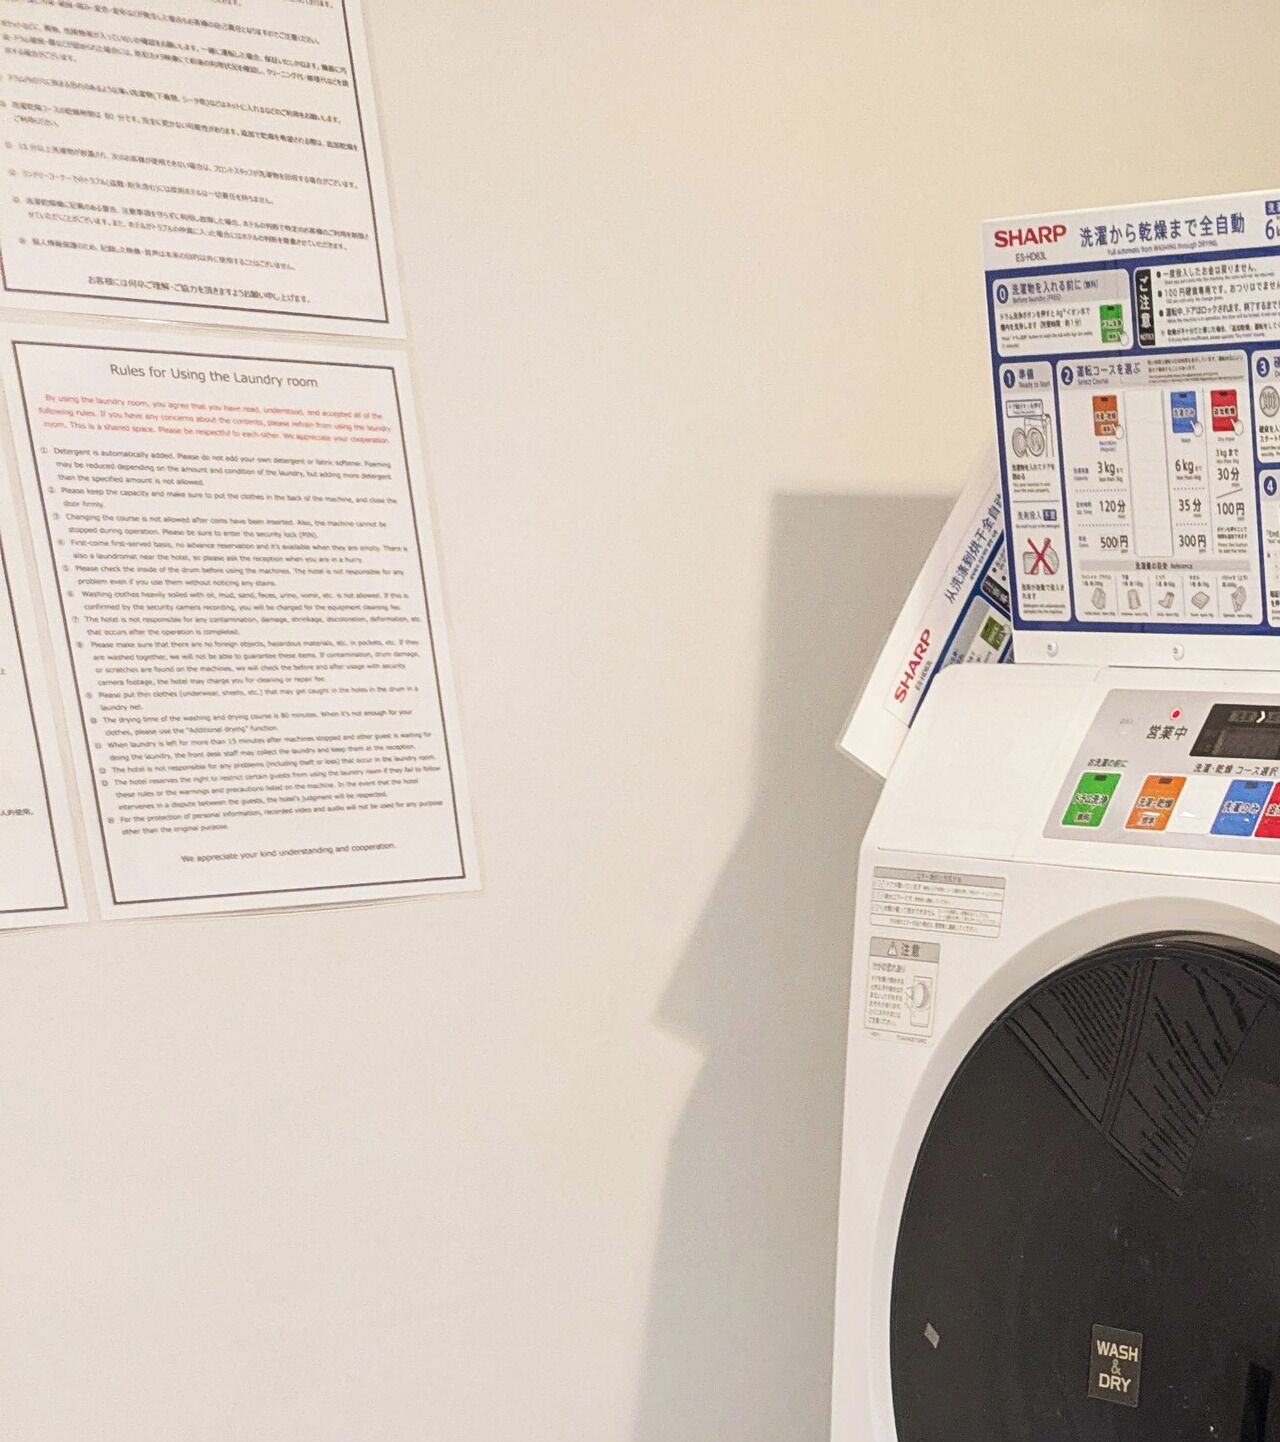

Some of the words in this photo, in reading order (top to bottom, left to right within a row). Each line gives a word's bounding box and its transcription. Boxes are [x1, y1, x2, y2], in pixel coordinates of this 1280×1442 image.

[994, 224, 1067, 248] SHARP
[1079, 212, 1245, 248] 洗濯から乾燥まで全自動
[110, 364, 146, 378] Rules
[149, 366, 166, 378] for
[170, 368, 206, 384] Using
[210, 370, 230, 384] the
[234, 373, 282, 388] Laundry
[287, 377, 318, 388] room
[894, 628, 932, 704] SHARP
[1147, 724, 1188, 740] 営業中
[1235, 766, 1280, 777] コース選択
[181, 855, 194, 863] We
[197, 852, 238, 864] appreciate
[240, 852, 258, 861] your
[260, 850, 276, 858] kind
[279, 846, 334, 858] understanding
[336, 844, 349, 853] and
[1096, 1340, 1138, 1362] WASH
[1111, 1359, 1121, 1375] &
[1098, 1372, 1132, 1392] DRY
